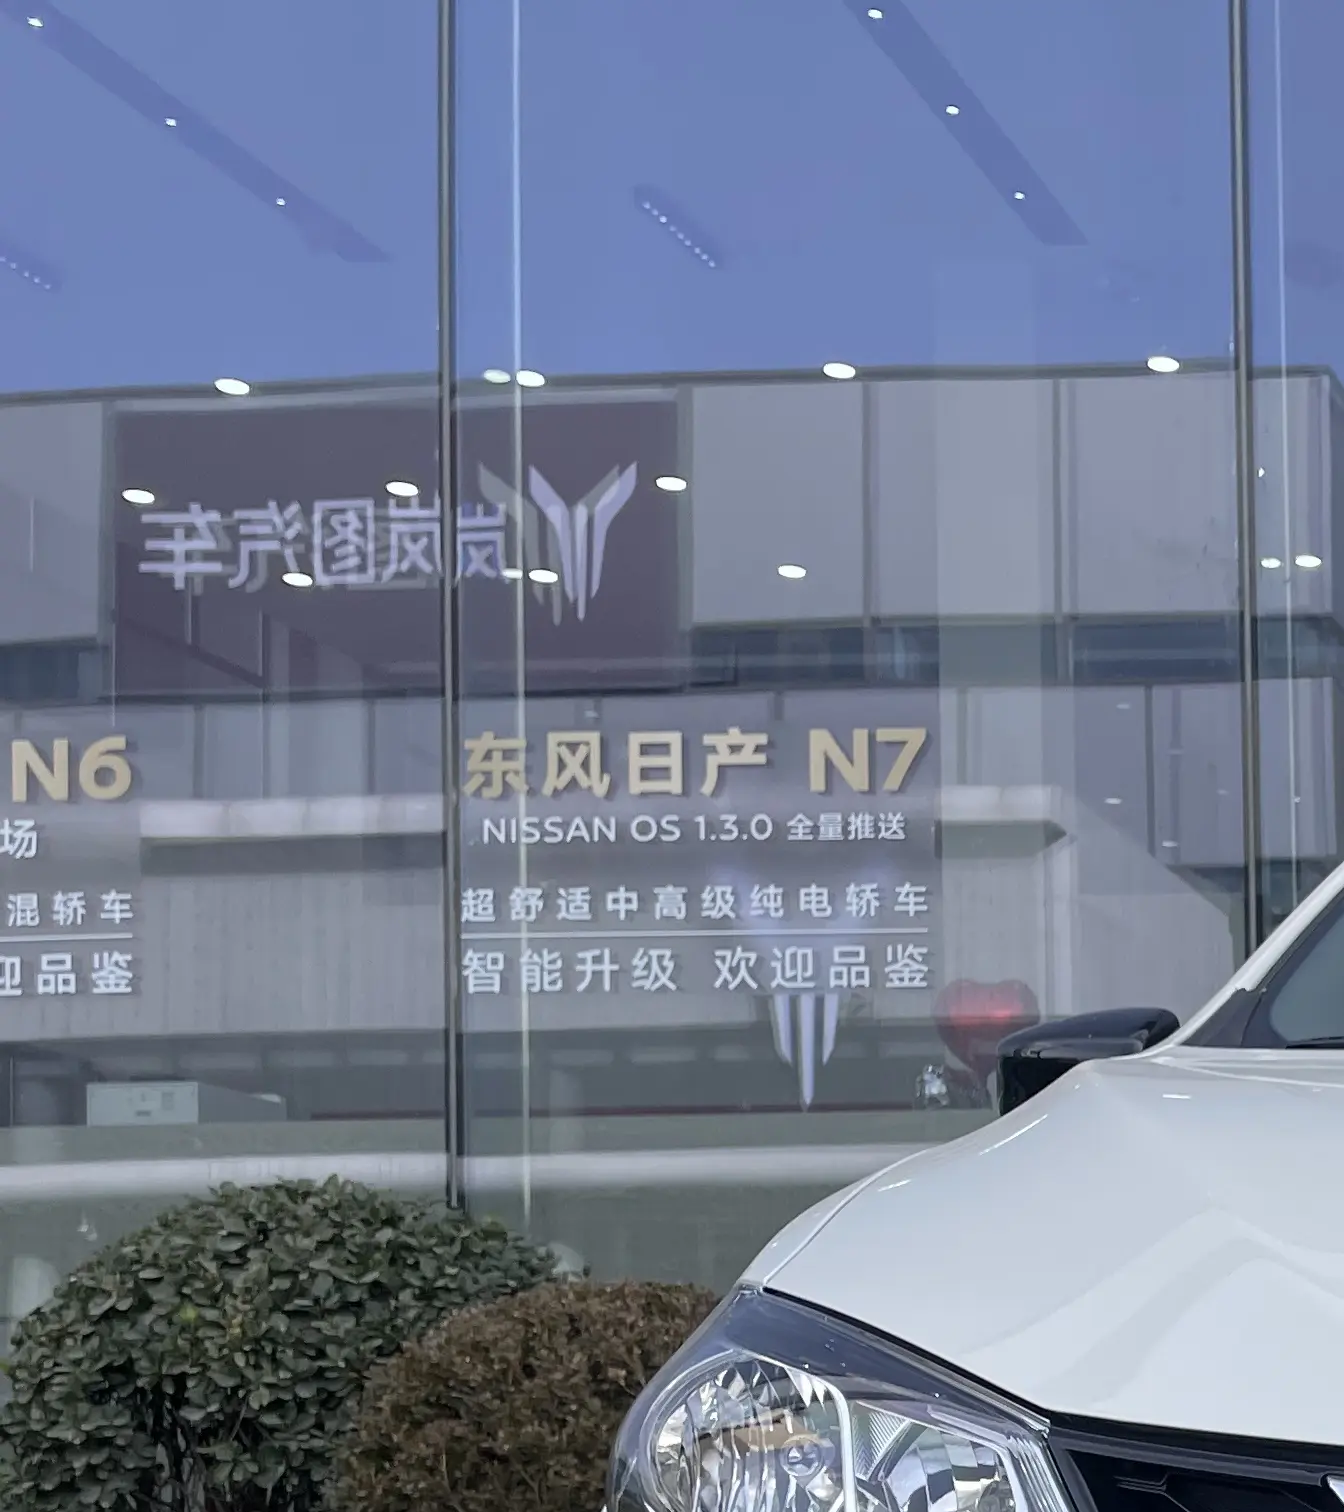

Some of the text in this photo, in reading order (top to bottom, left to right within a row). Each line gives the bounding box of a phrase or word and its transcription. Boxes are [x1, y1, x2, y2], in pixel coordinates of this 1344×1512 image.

[11, 735, 133, 803] N6
[462, 727, 928, 799] 东风日产 N7
[0, 818, 38, 860] 场
[482, 812, 906, 844] NISSAN OS 1.3.0 全量推送
[7, 888, 134, 927] 混轿车
[461, 882, 929, 924] 超舒适中高级纯电轿车
[461, 944, 930, 994] 智能升级 欢迎品鉴
